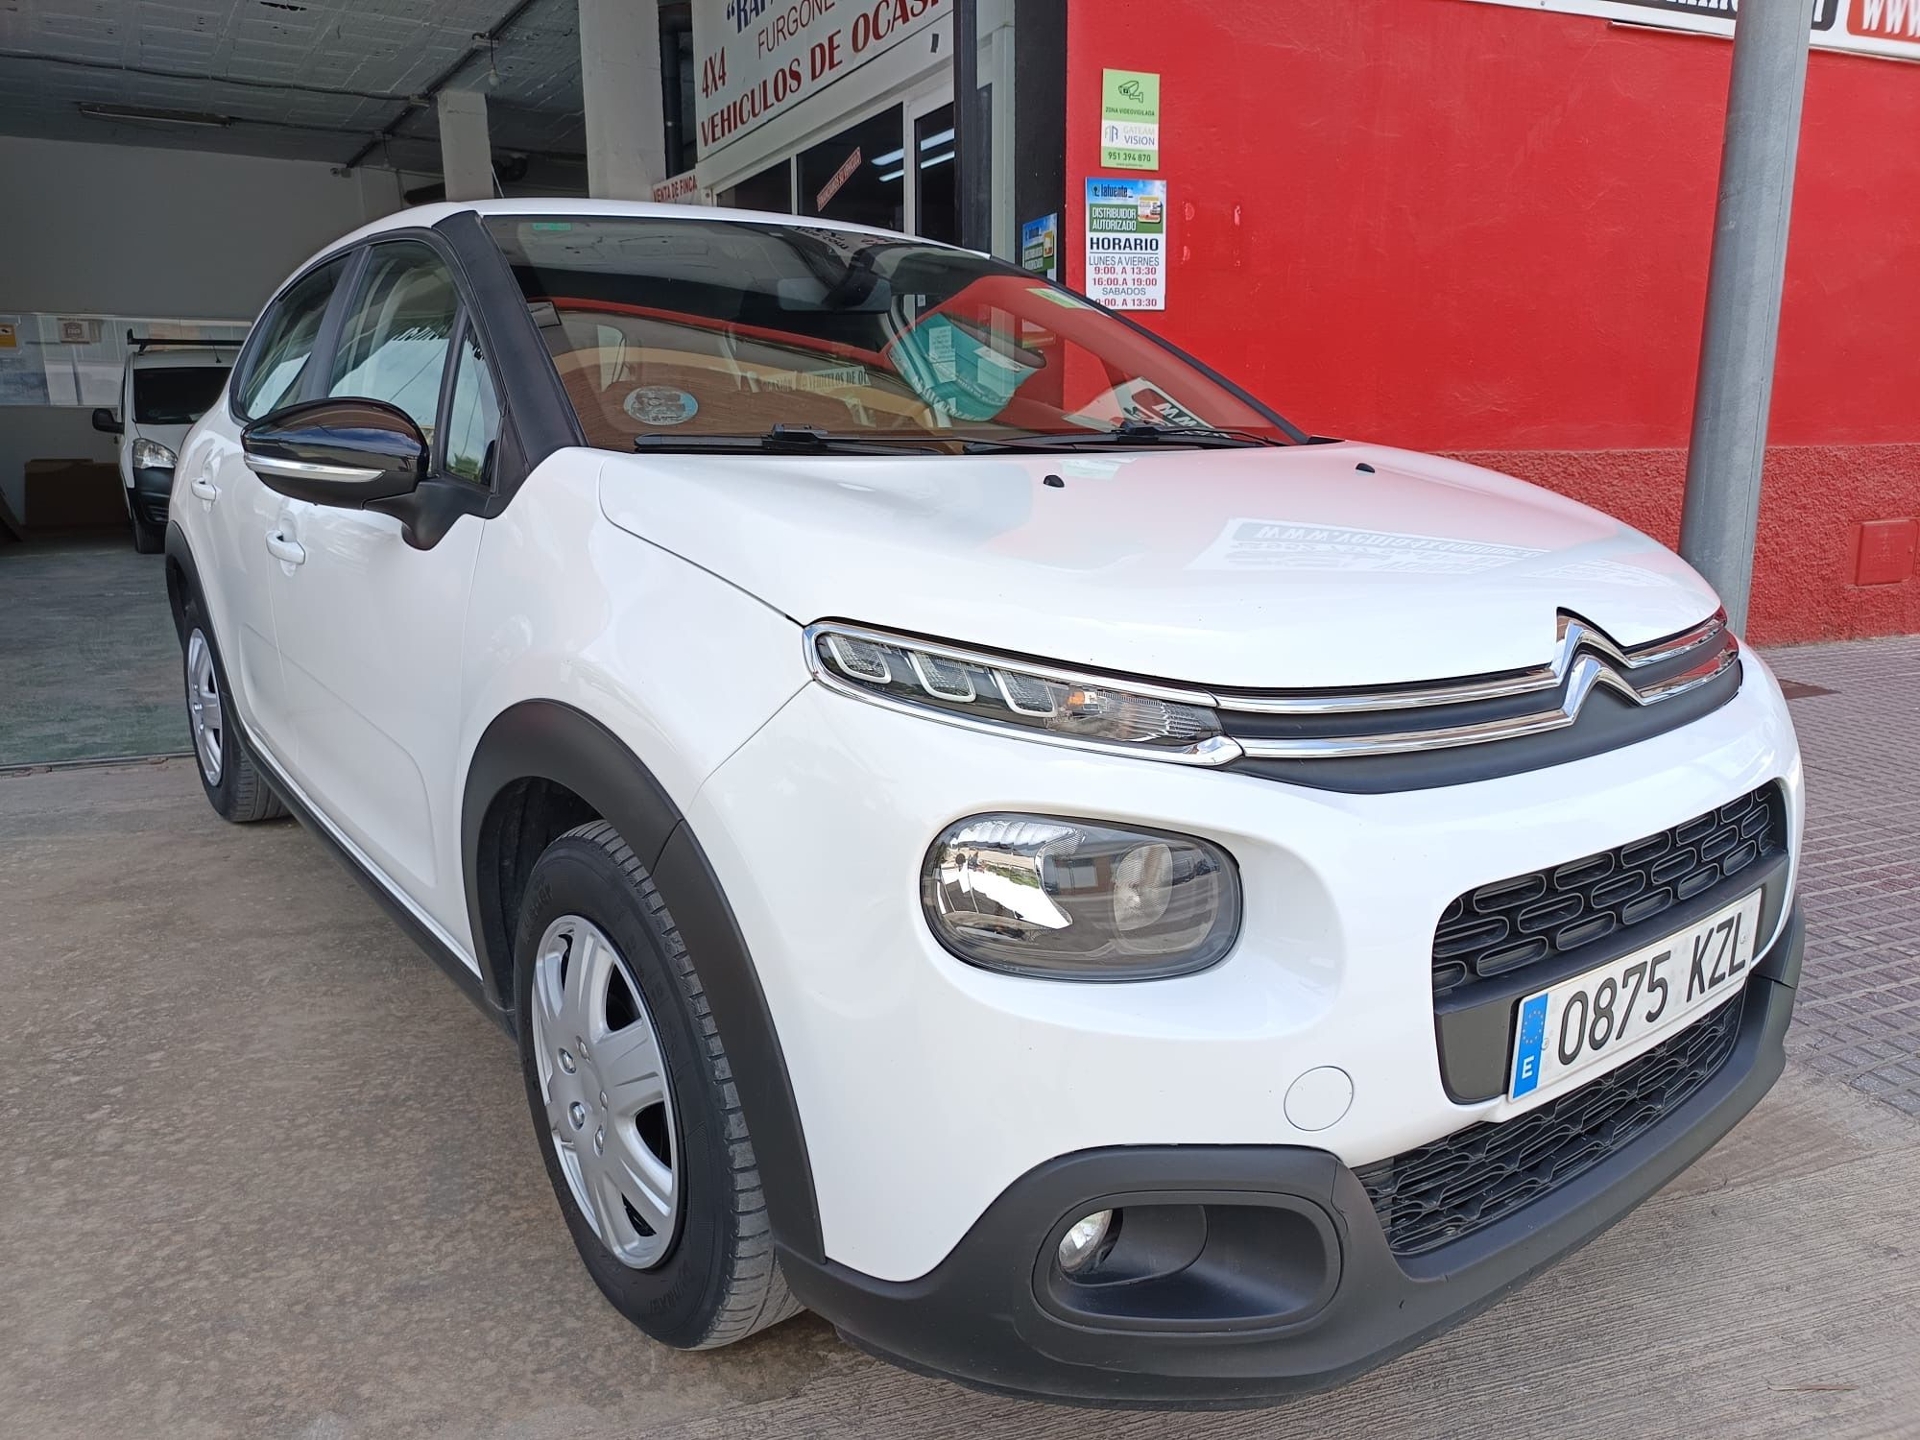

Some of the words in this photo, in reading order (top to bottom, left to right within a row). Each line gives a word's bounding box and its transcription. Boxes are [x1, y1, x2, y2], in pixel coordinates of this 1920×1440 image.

[702, 46, 726, 99] 4X4
[701, 58, 802, 147] VEHICULOS
[810, 29, 843, 82] DE
[1124, 135, 1155, 146] VISION
[1108, 151, 1120, 160] 951
[1123, 152, 1136, 161] 394
[1092, 207, 1137, 220] DISTRIBUIDOR
[1092, 220, 1137, 231] AUTORIZADO
[1090, 237, 1159, 251] HORARIO
[1089, 256, 1116, 266] LUNES
[1117, 256, 1123, 266] A
[1125, 256, 1160, 267] VIERNES
[1121, 267, 1127, 275] A
[1131, 267, 1157, 275] 13:30
[1132, 277, 1158, 287] 19:00
[1102, 287, 1147, 296] SABADOS
[1122, 298, 1128, 307] A
[1132, 298, 1157, 307] 13:30
[1558, 951, 1671, 1066] 0875
[1686, 912, 1746, 1002] KZL
